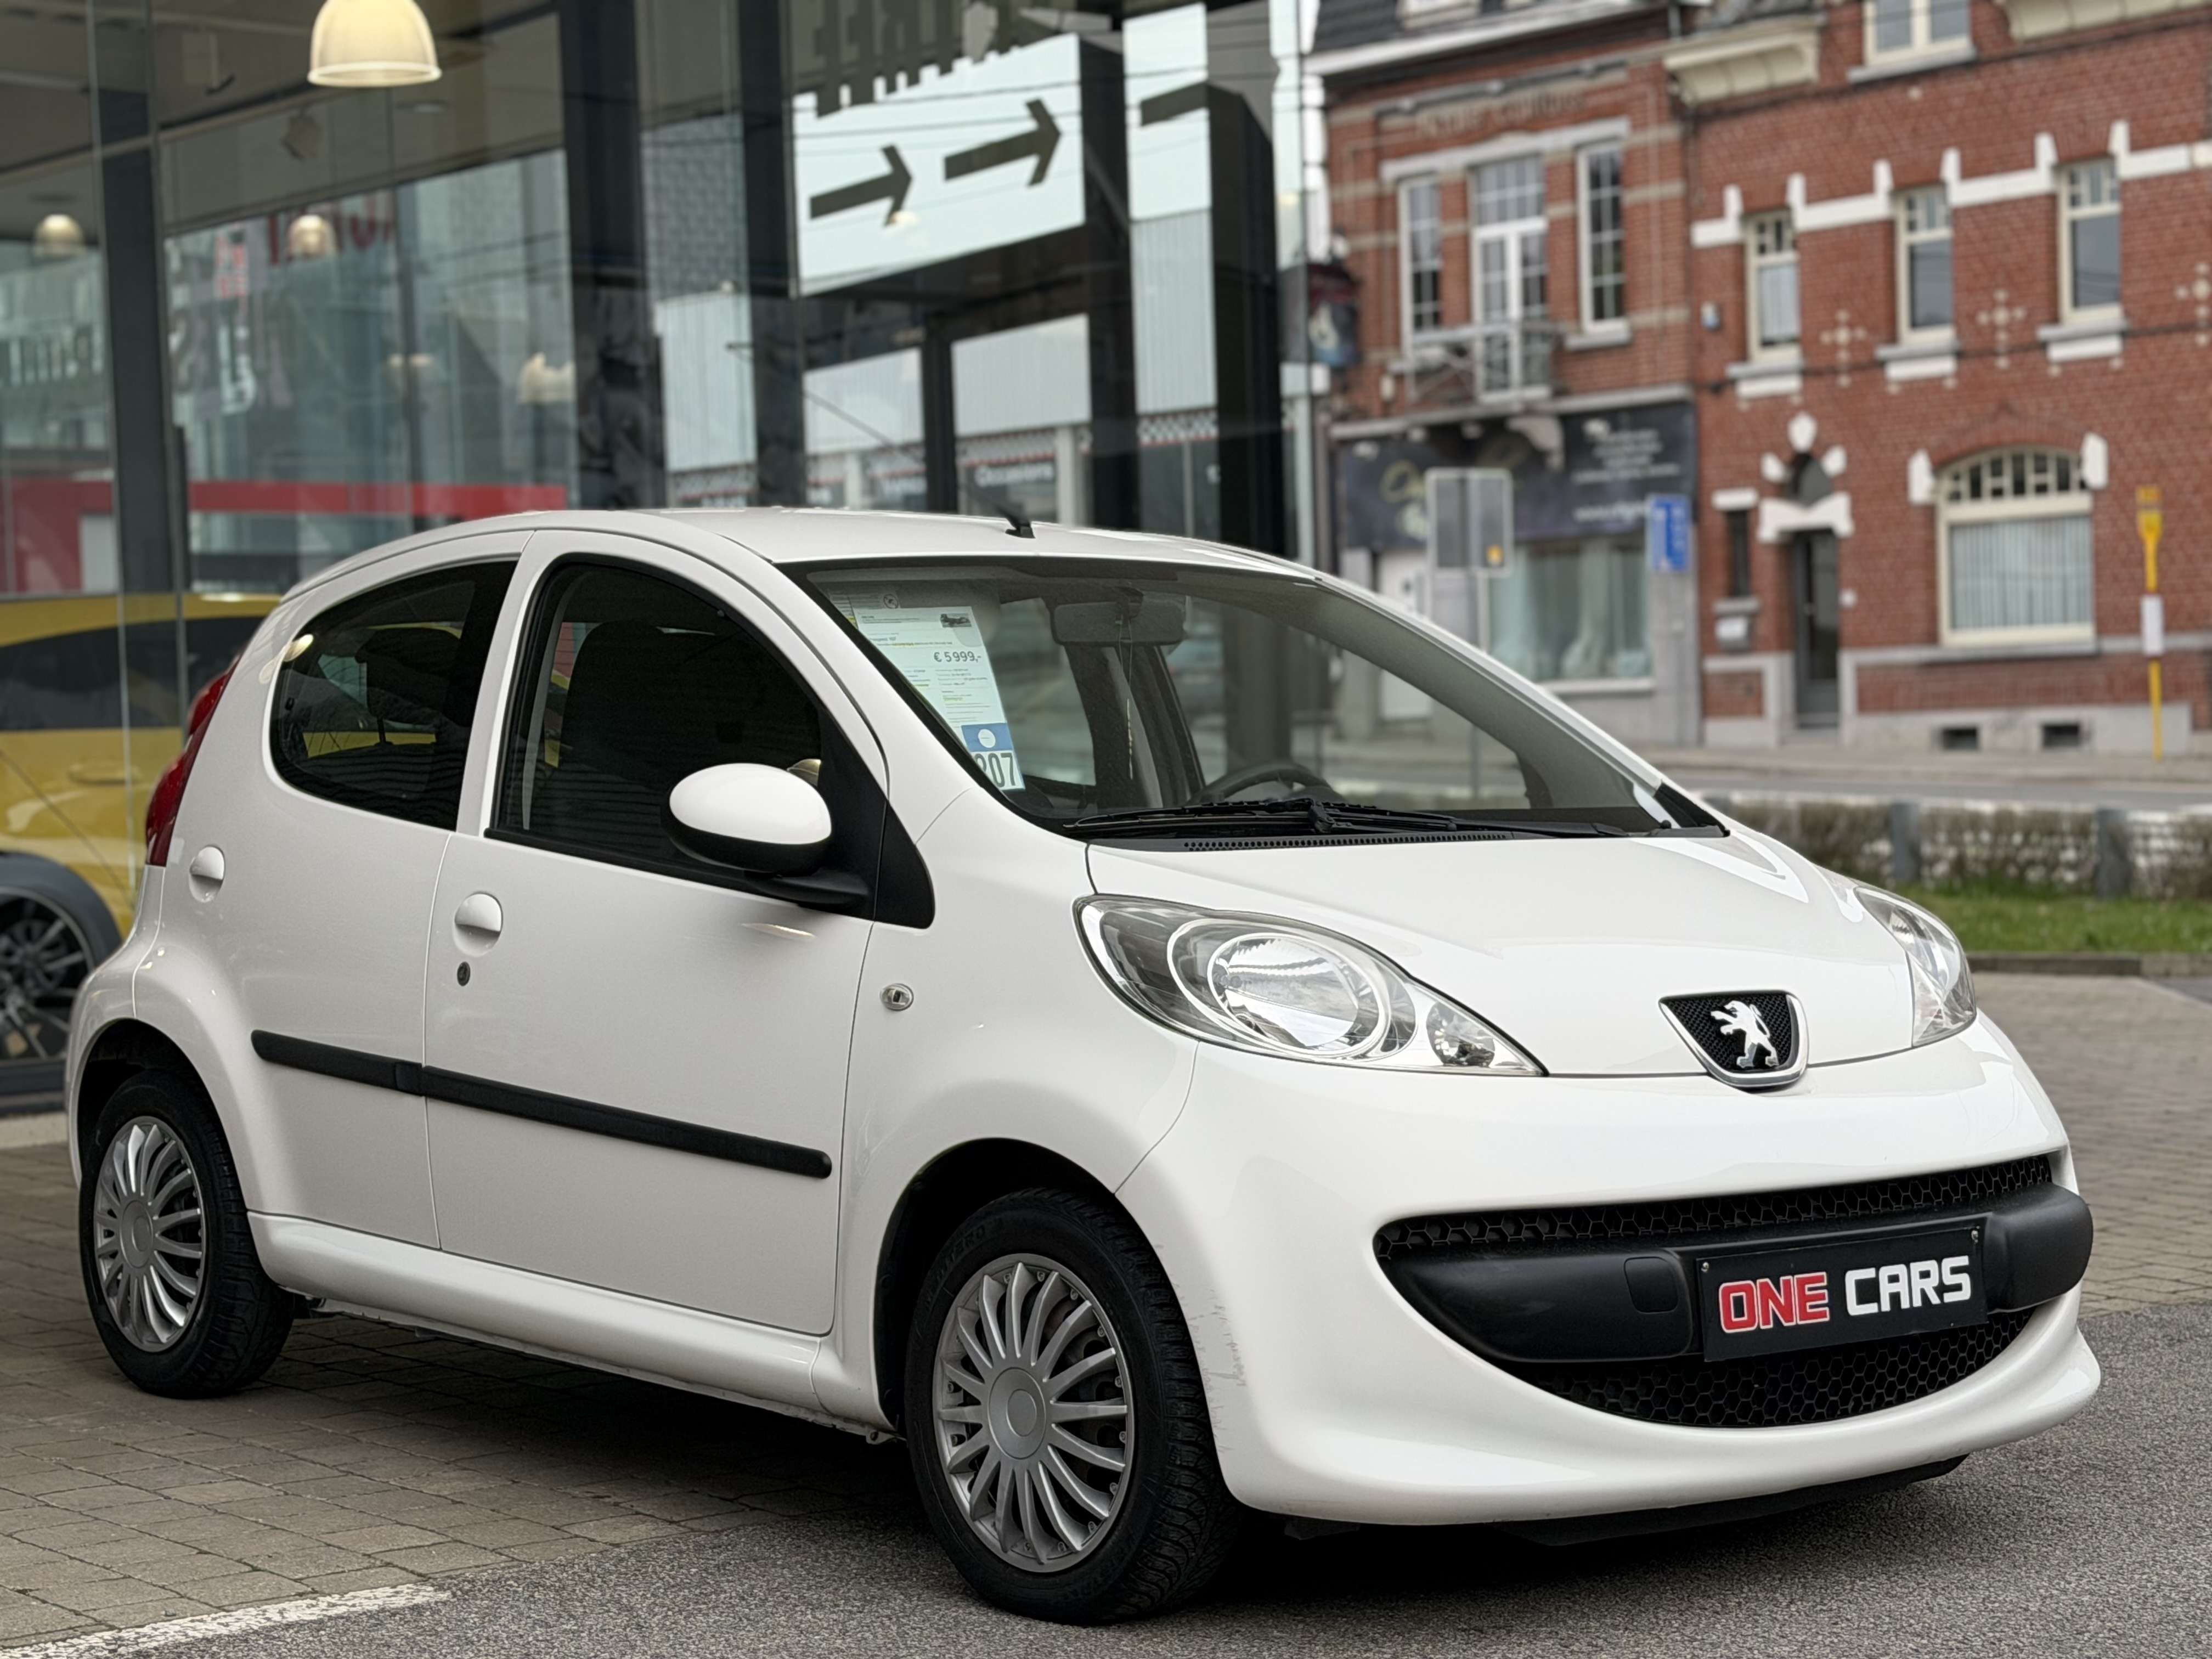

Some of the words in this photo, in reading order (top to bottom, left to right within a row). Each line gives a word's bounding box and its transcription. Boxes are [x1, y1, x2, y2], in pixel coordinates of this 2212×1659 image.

[934, 651, 943, 662] €
[1719, 1272, 1830, 1334] ONE
[1845, 1255, 1971, 1316] CARS
